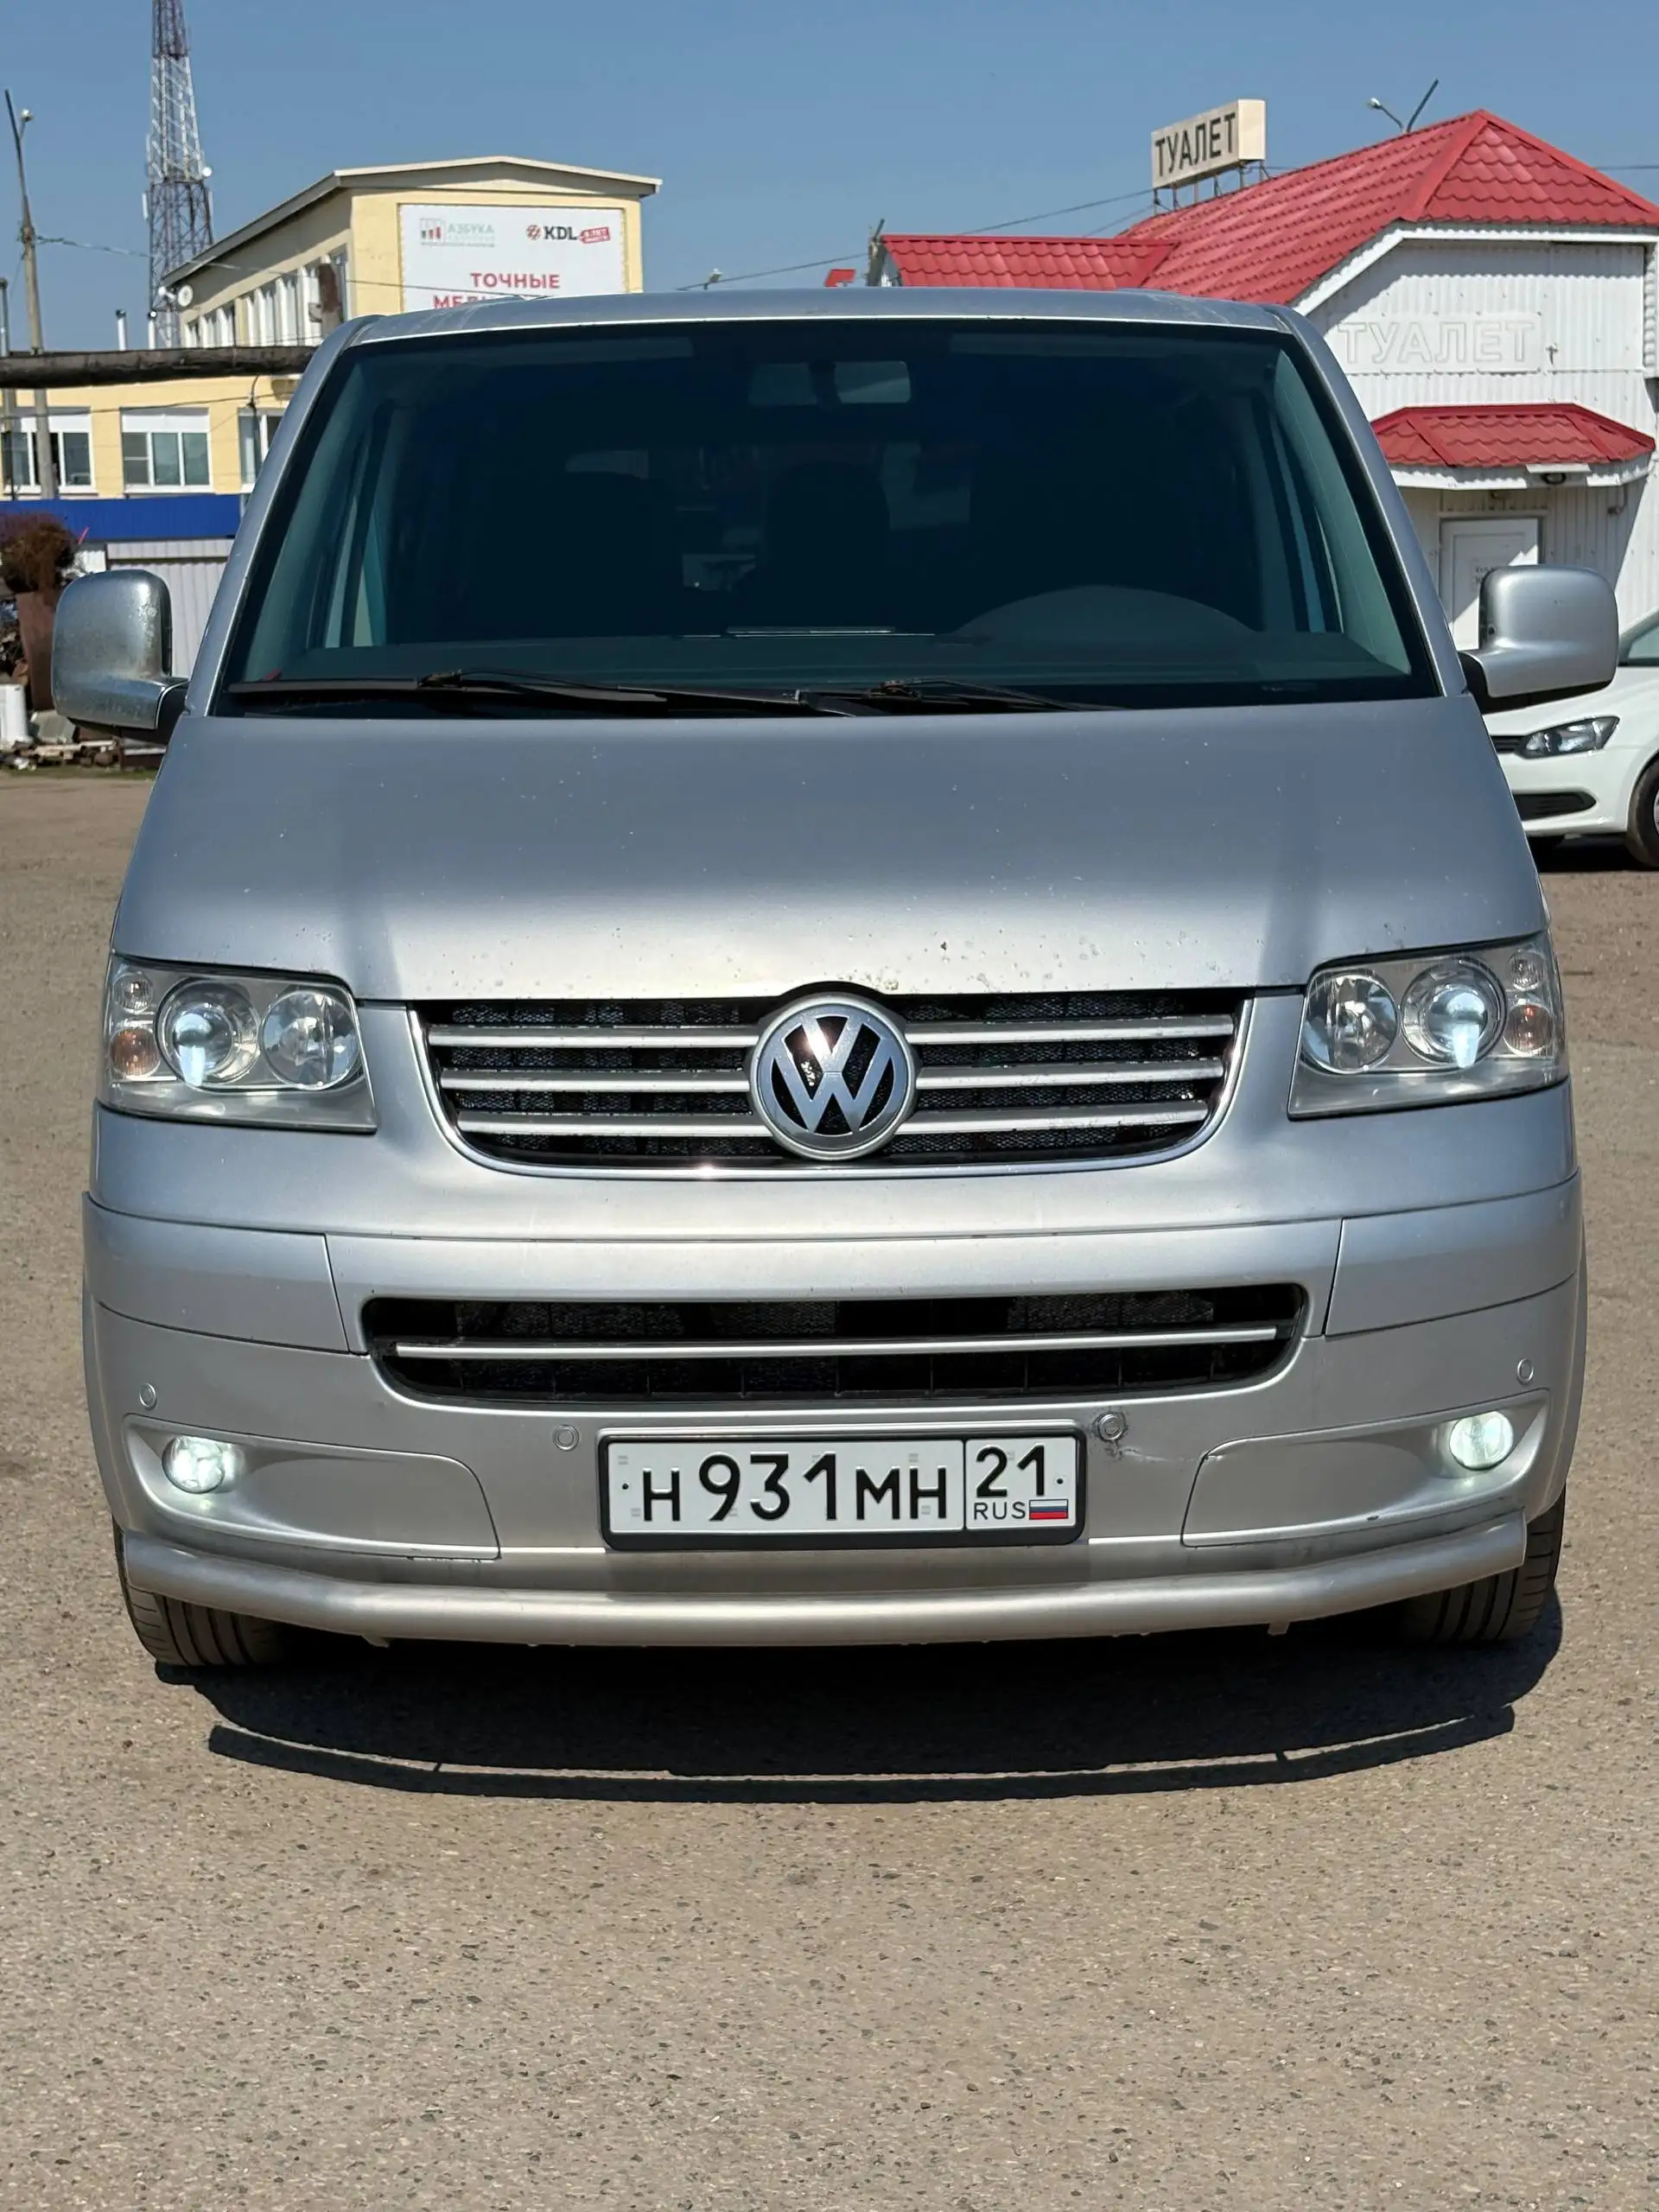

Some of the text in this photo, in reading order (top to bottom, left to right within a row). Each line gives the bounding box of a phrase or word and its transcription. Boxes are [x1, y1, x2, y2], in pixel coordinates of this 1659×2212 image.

[1154, 112, 1236, 177] ТУАЛЕТ
[543, 226, 578, 241] KDL
[470, 272, 561, 289] ТОЧНЫЕ
[1338, 321, 1534, 364] ТУАЛЕТ
[975, 1444, 1045, 1498] 21
[973, 1500, 1027, 1521] RUS
